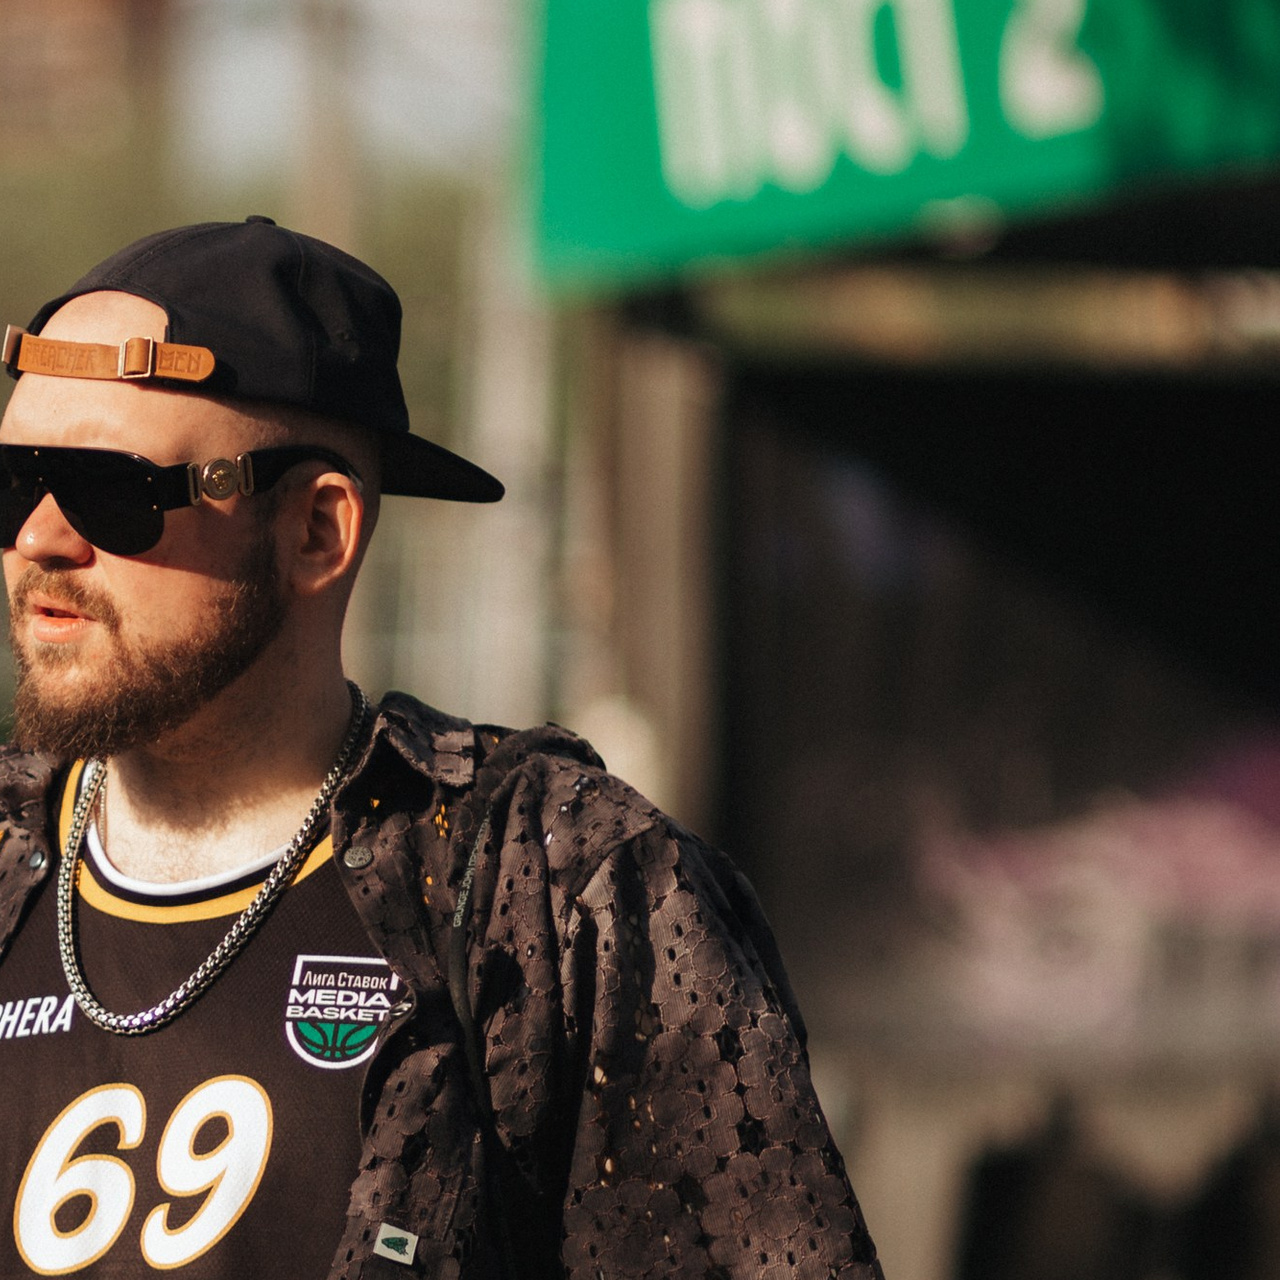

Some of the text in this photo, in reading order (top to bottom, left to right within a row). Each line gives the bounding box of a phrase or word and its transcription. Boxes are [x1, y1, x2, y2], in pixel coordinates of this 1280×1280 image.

[158, 350, 202, 375] MEN
[453, 889, 470, 928] GRUNGE
[462, 867, 476, 890] JOHN
[288, 988, 392, 1008] MEDIA
[285, 1005, 389, 1022] BASKET
[13, 1074, 274, 1276] 69
